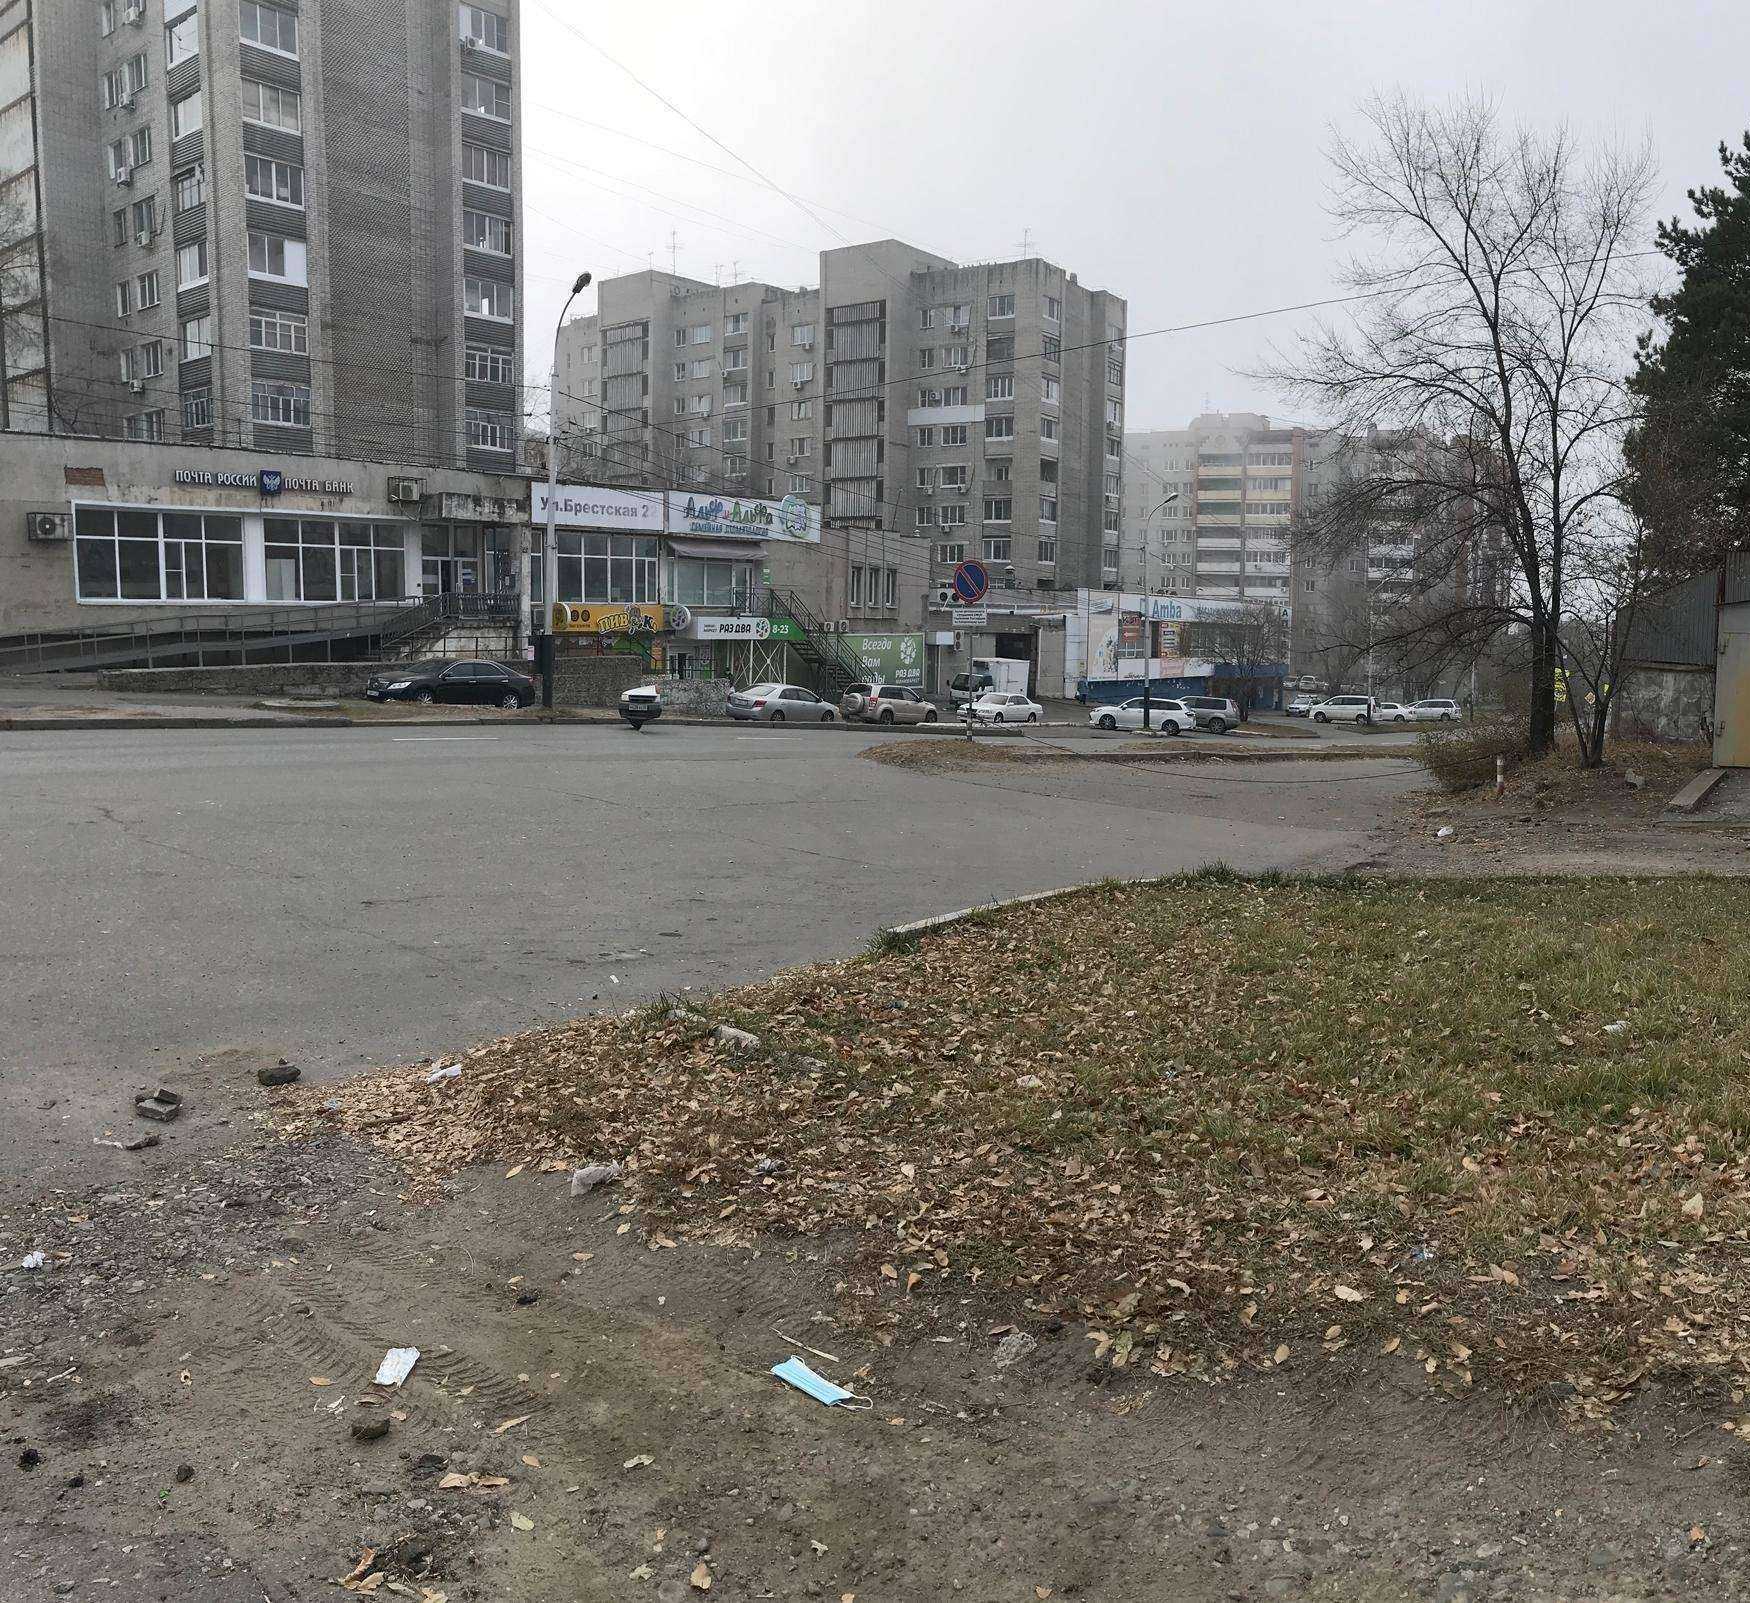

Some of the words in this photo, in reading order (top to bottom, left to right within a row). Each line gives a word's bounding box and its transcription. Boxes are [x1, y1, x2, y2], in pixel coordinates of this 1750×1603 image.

[175, 470, 212, 484] ПОЧТА
[217, 472, 257, 487] РОССИИ
[284, 478, 319, 491] ПОЧТА
[325, 480, 354, 493] БАНК
[1152, 600, 1182, 620] Amba
[772, 624, 790, 634] 8-23
[862, 637, 892, 651] Всегда
[862, 655, 881, 668] Вам
